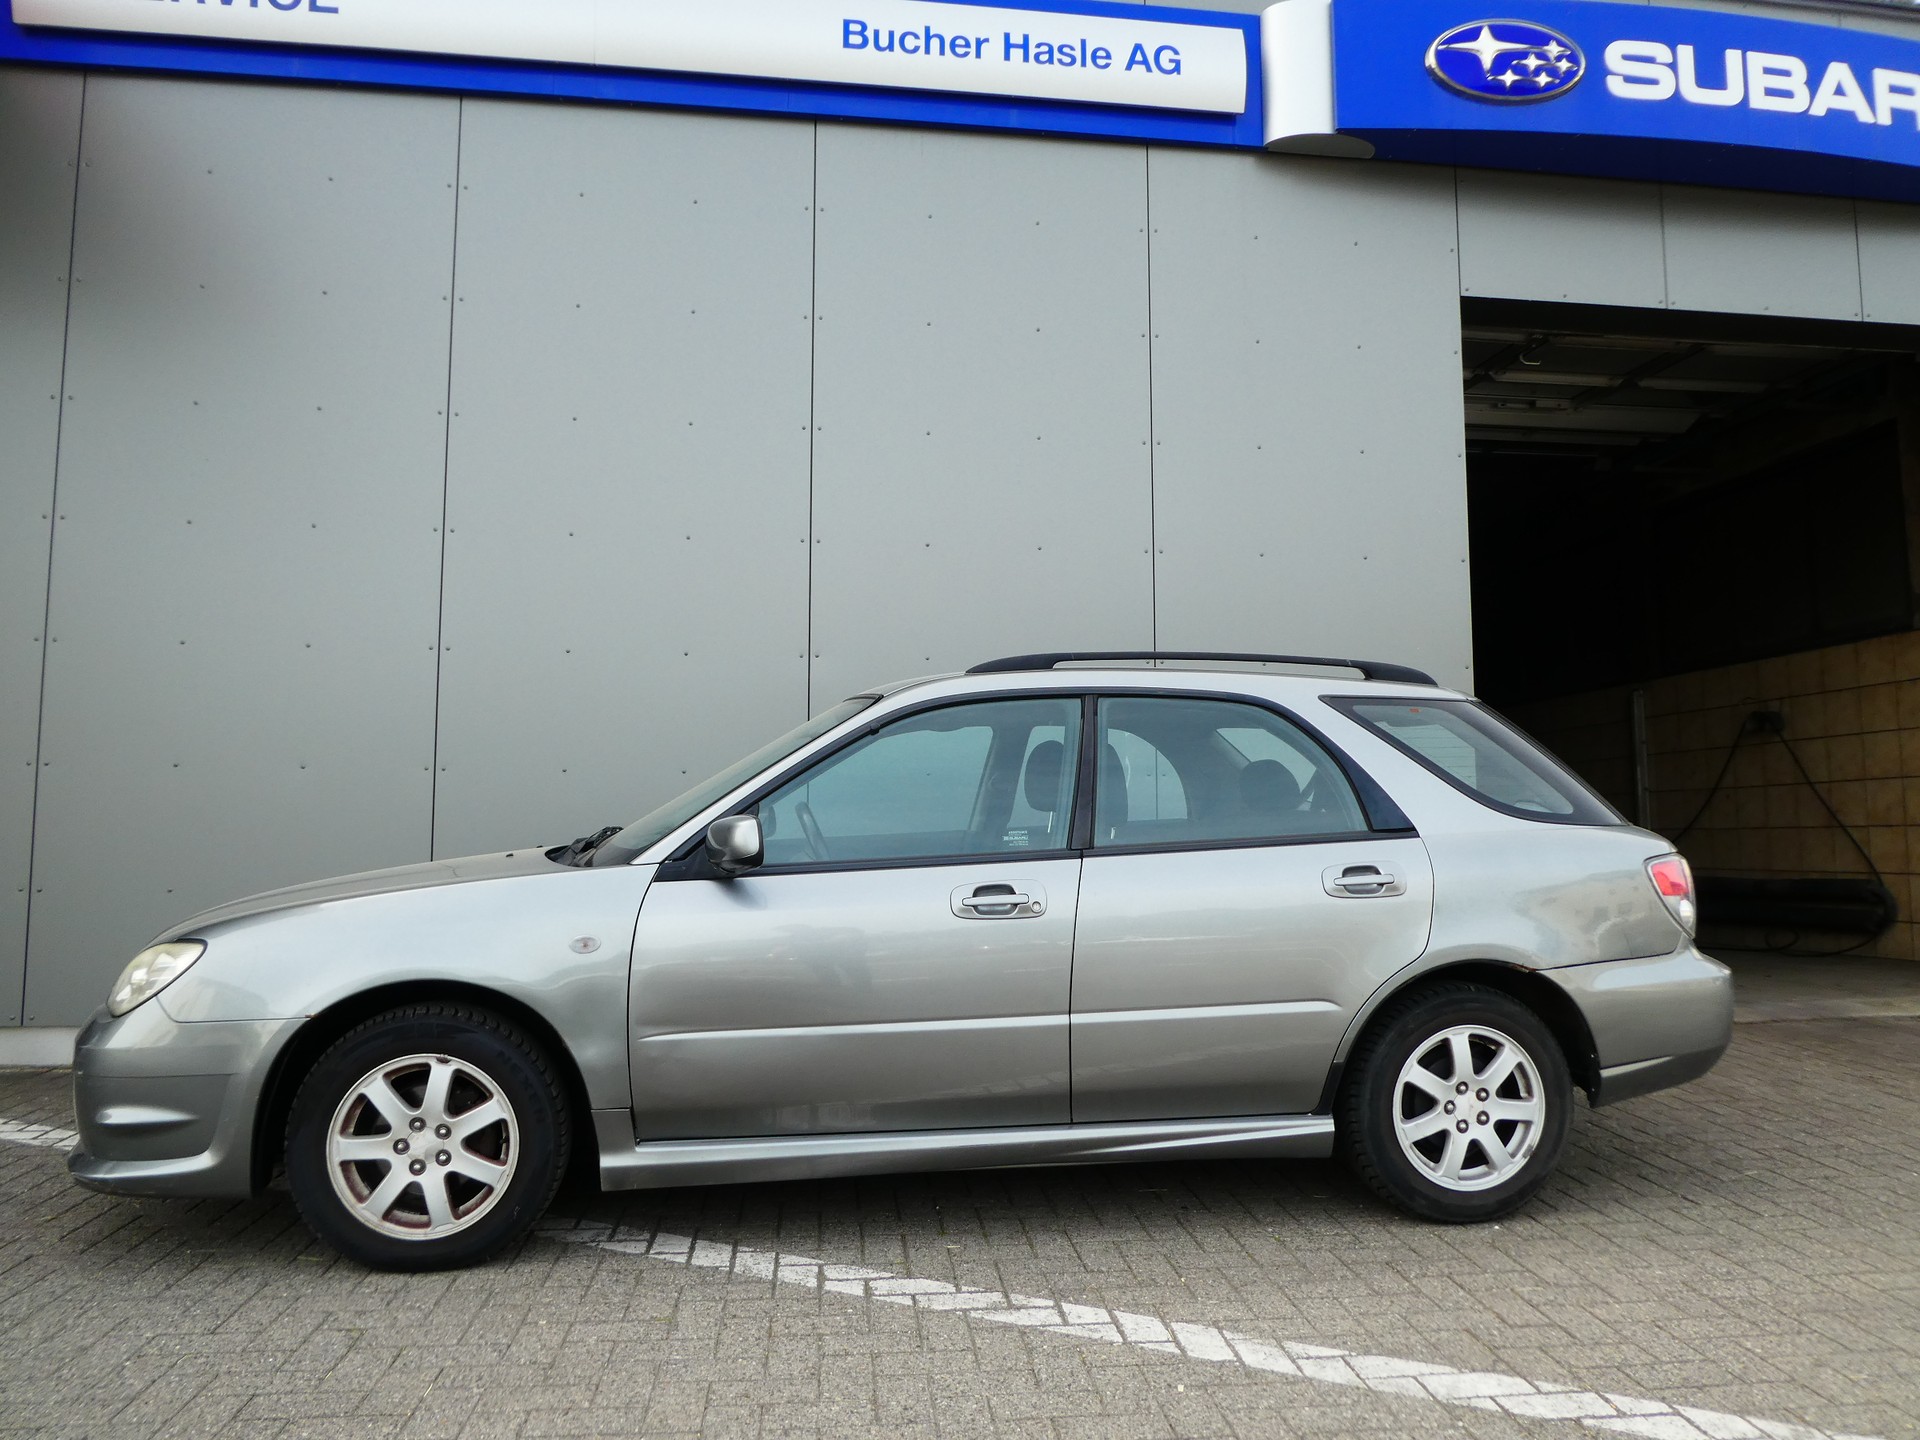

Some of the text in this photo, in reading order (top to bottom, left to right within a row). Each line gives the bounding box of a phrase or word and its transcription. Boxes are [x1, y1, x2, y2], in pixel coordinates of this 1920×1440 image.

[843, 19, 1182, 75] Bucher Hasle AG
